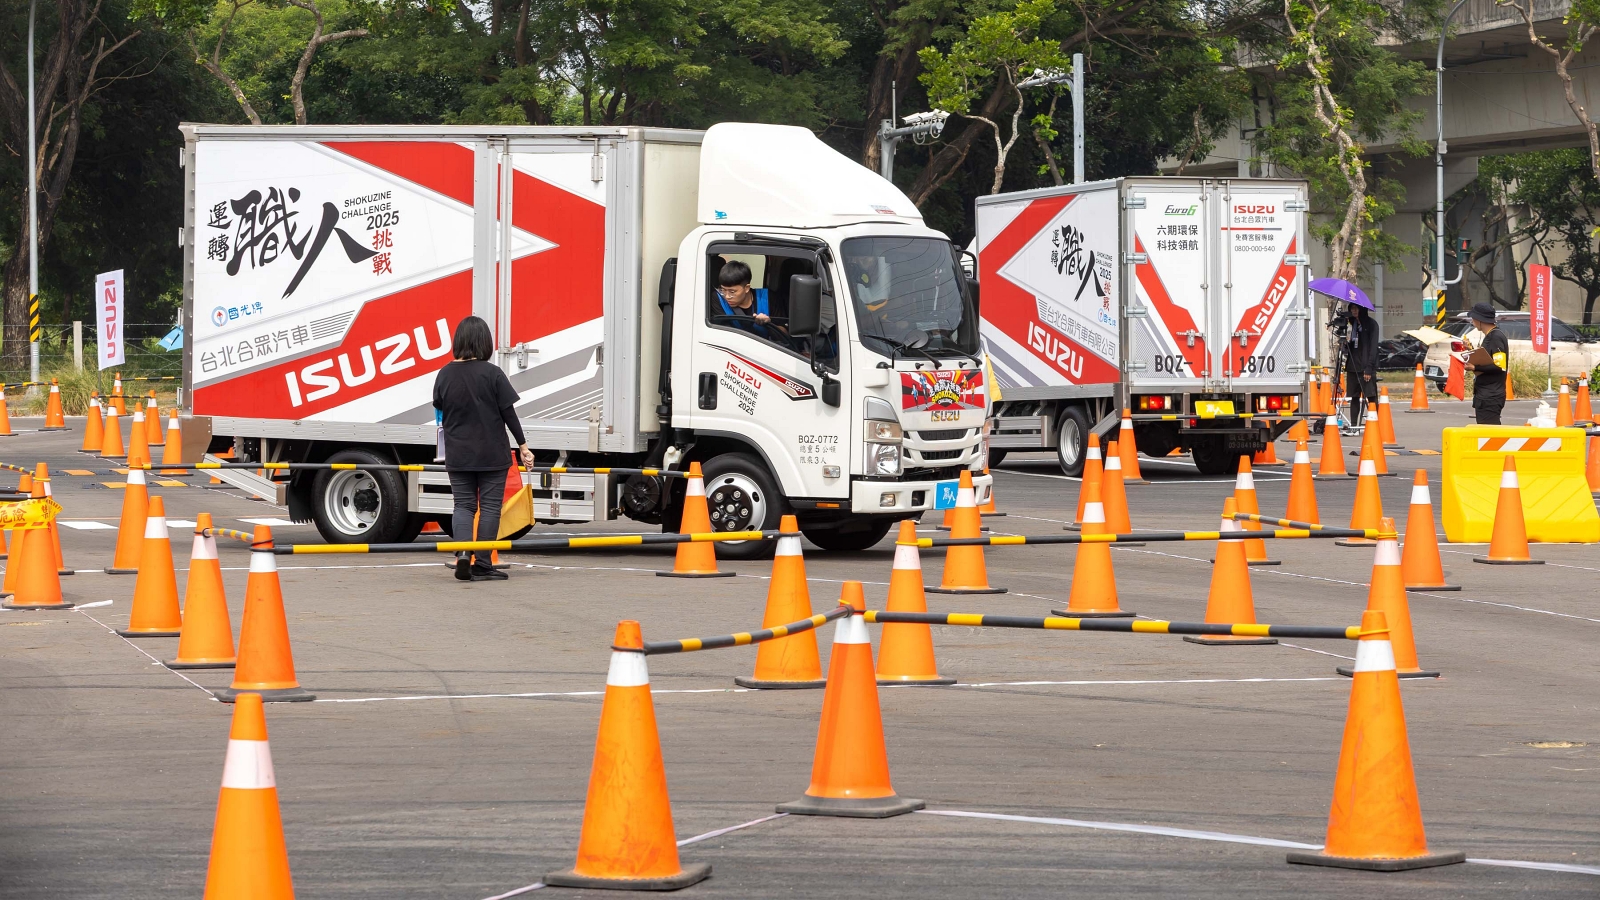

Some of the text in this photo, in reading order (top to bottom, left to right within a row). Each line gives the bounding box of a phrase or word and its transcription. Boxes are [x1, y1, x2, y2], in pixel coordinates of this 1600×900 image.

[343, 190, 392, 208] SHOKUZINE
[341, 202, 392, 220] CHALLENGE
[1233, 205, 1275, 214] ISUZU
[366, 210, 400, 231] 2025
[206, 200, 233, 262] 運轉
[1156, 224, 1199, 236] 六期環保
[226, 186, 380, 299] 職人
[1156, 239, 1199, 251] 科技領航
[371, 228, 394, 276] 挑戰
[1099, 266, 1112, 281] 2025
[1251, 275, 1288, 335] ISUZU
[1027, 321, 1084, 379] ISUZU
[284, 317, 453, 408] ISUZU
[1154, 355, 1276, 373] BQZ- 1870
[726, 361, 762, 390] ISUZU
[719, 378, 757, 408] CHALLENGE
[723, 371, 759, 400] SHOKUZINE
[785, 380, 806, 394] ISUZU
[737, 400, 755, 416] 2025
[930, 410, 960, 422] ISUZU
[798, 435, 839, 444] BQZ-0772
